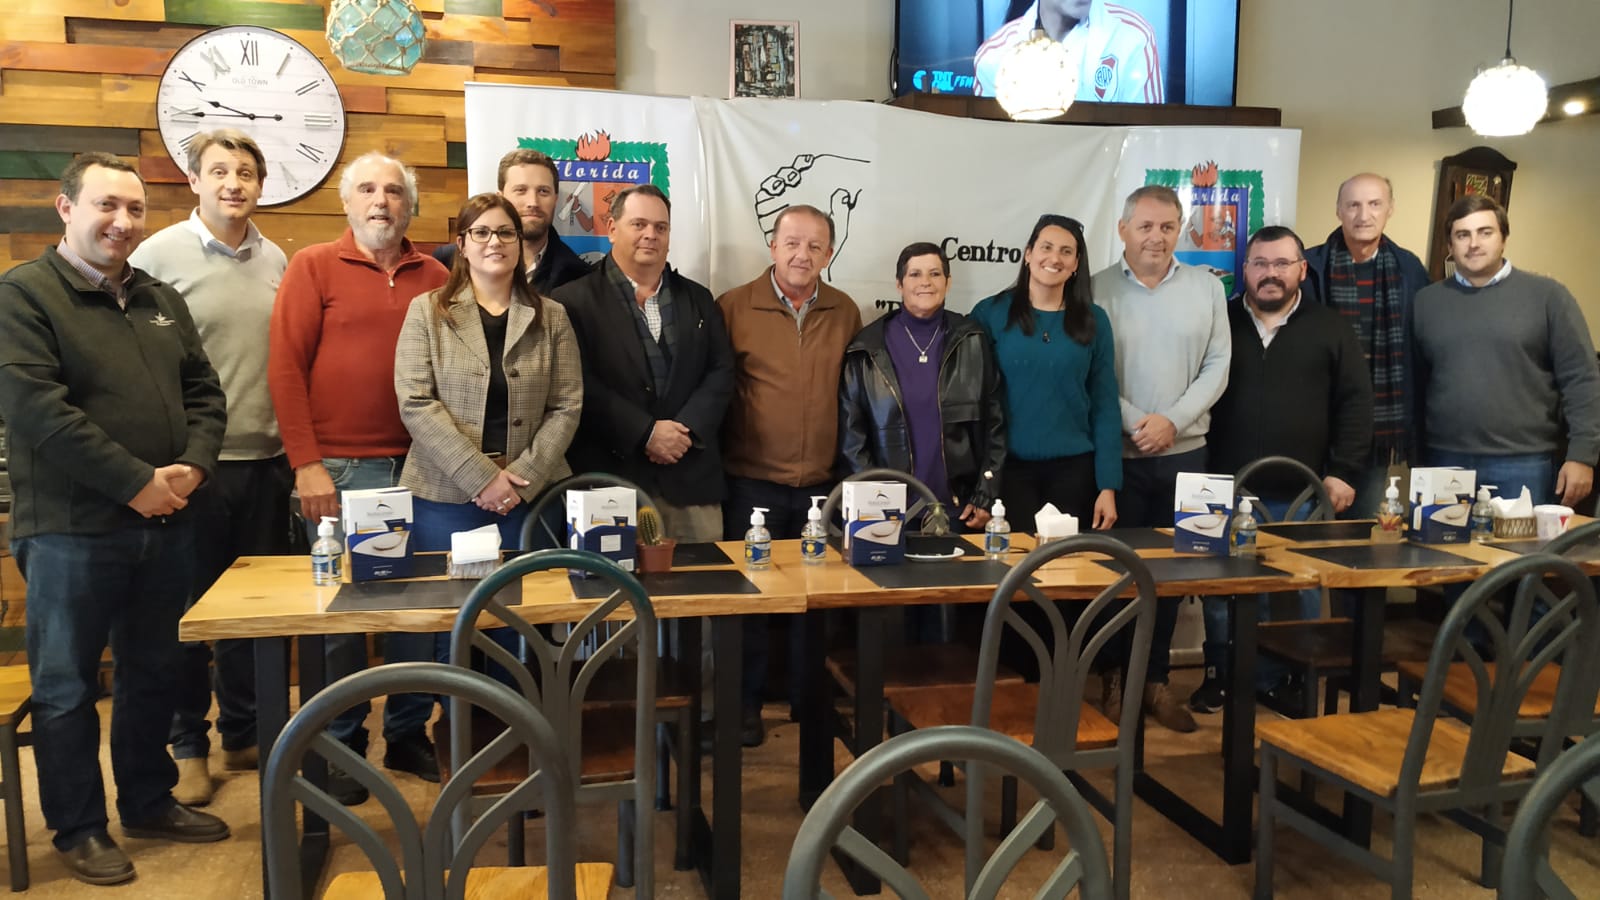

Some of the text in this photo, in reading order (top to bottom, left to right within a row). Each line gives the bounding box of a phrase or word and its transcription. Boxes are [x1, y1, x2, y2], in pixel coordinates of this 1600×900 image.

[240, 39, 258, 66] XII
[178, 71, 207, 93] X
[248, 78, 269, 86] TOWN
[940, 237, 1022, 263] Centro
